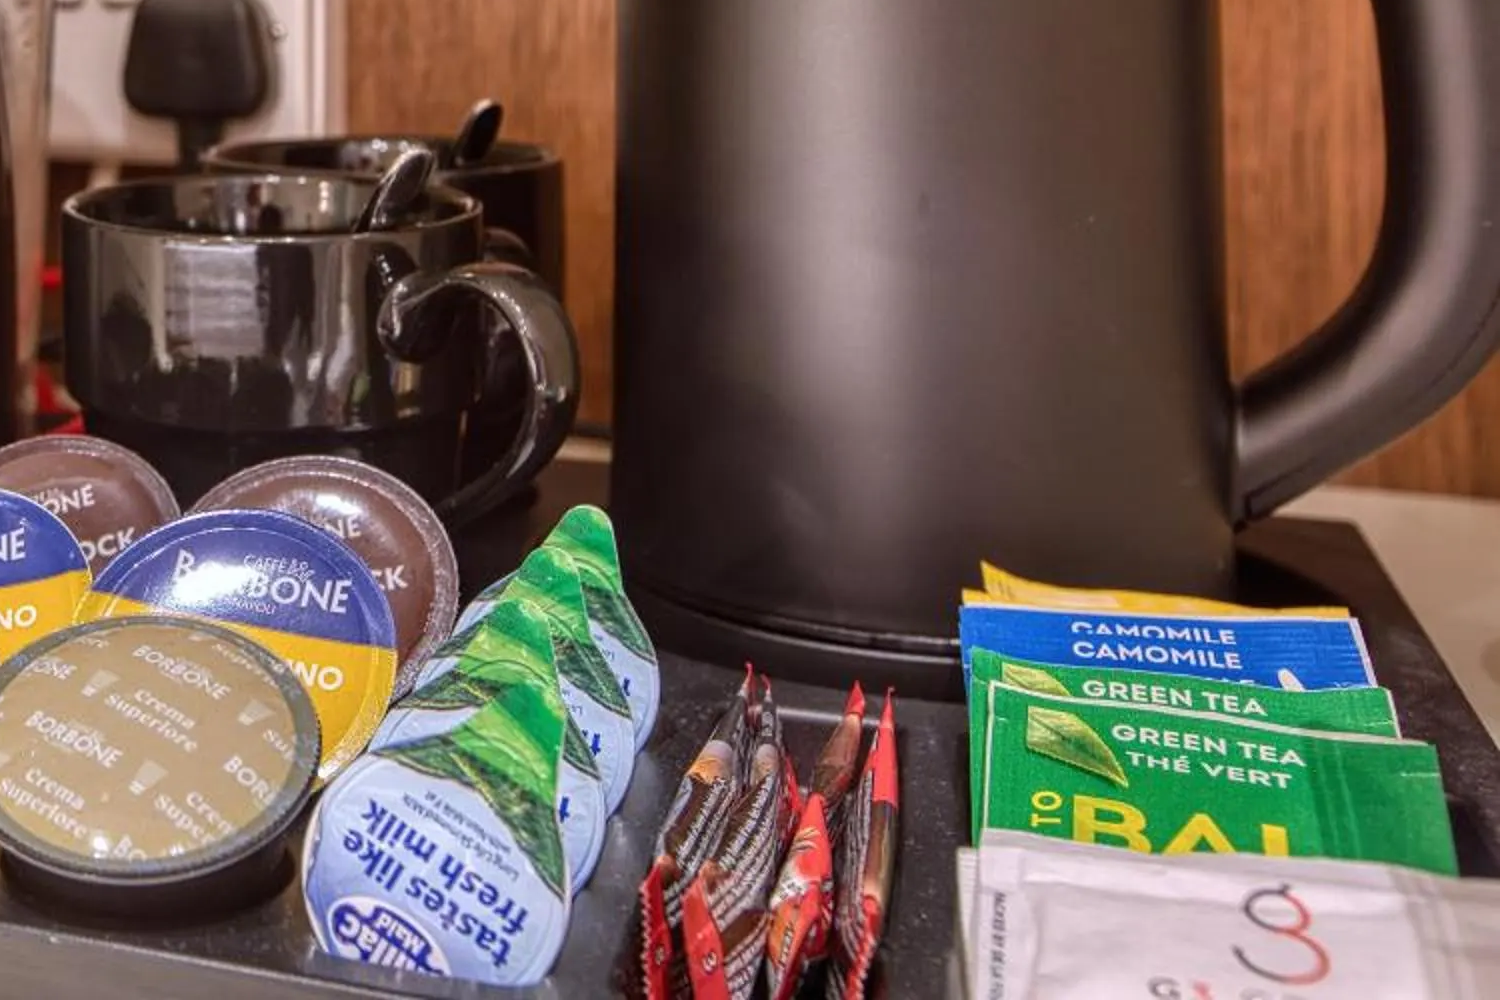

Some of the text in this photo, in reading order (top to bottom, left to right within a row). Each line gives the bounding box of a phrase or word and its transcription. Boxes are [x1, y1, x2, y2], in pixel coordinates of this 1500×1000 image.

[172, 550, 351, 613] BBONE
[1071, 621, 1237, 645] CAMOMILE
[132, 645, 232, 700] BORBONE
[1073, 641, 1243, 669] CAMOMILE
[1082, 679, 1268, 717] GREEN TEA
[25, 711, 123, 768] BORBONE
[1111, 724, 1307, 767] GREEN TEA
[1125, 751, 1292, 789] THÉ VERT
[1031, 790, 1063, 827] TO
[361, 799, 528, 936] fresh milk
[342, 828, 511, 968] tastes like
[375, 911, 427, 952] Maid
